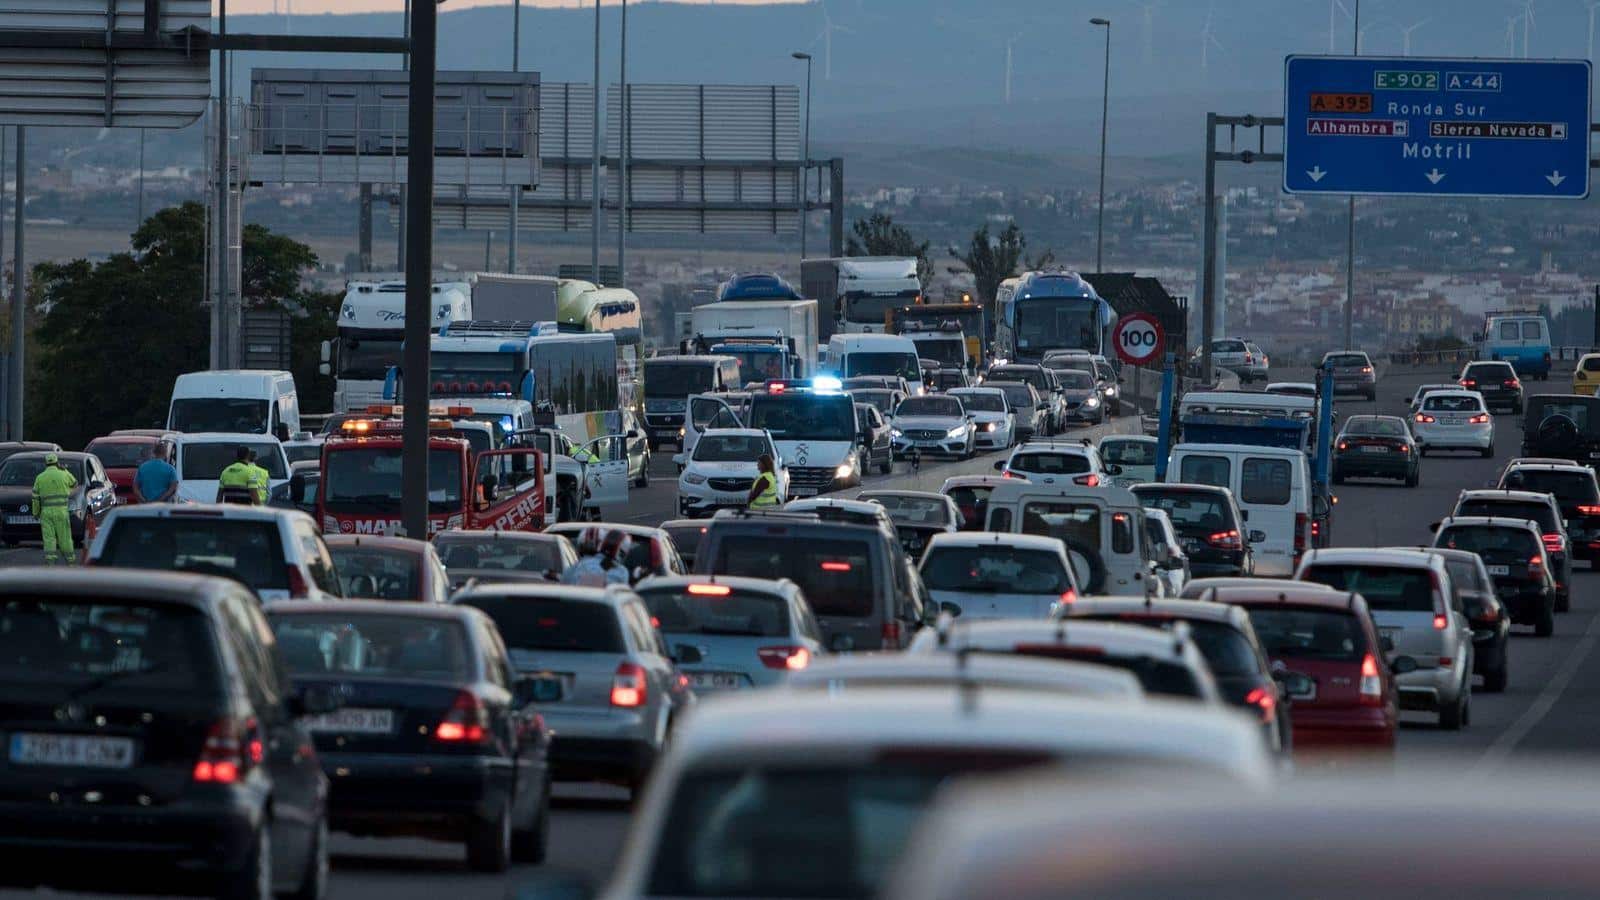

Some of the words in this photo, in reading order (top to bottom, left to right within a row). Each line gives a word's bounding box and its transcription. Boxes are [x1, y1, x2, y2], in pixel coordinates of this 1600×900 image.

[1376, 73, 1436, 88] E-902
[1450, 74, 1499, 89] A-44
[1387, 102, 1443, 116] Ronda
[1455, 102, 1486, 117] Sur
[1311, 121, 1387, 134] Alhambra
[1433, 123, 1481, 136] Sierra
[1489, 124, 1546, 137] Nevada
[1402, 142, 1471, 160] Motril
[1121, 330, 1156, 347] 100
